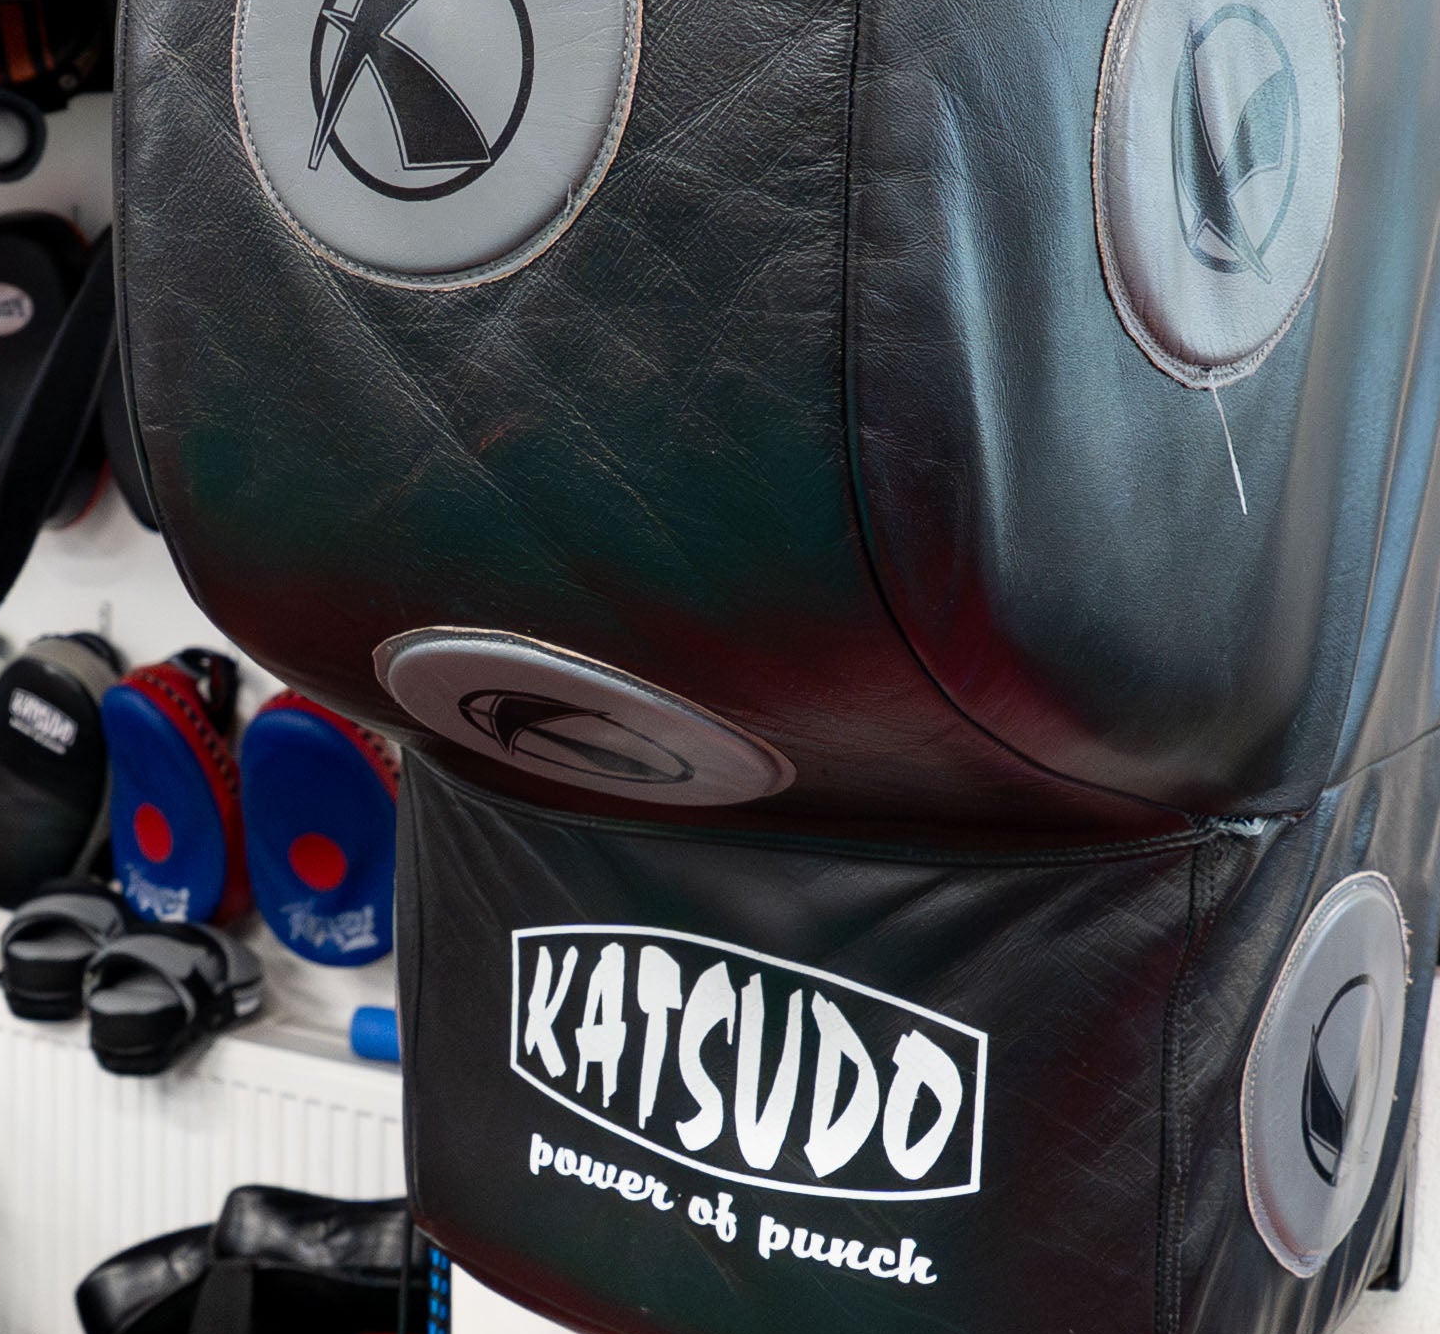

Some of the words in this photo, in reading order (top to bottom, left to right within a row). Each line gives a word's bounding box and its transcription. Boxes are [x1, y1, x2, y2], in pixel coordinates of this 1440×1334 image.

[524, 942, 963, 1181] KATSUDO
[529, 1132, 675, 1212] power
[687, 1191, 738, 1244] of
[758, 1214, 938, 1285] punch
